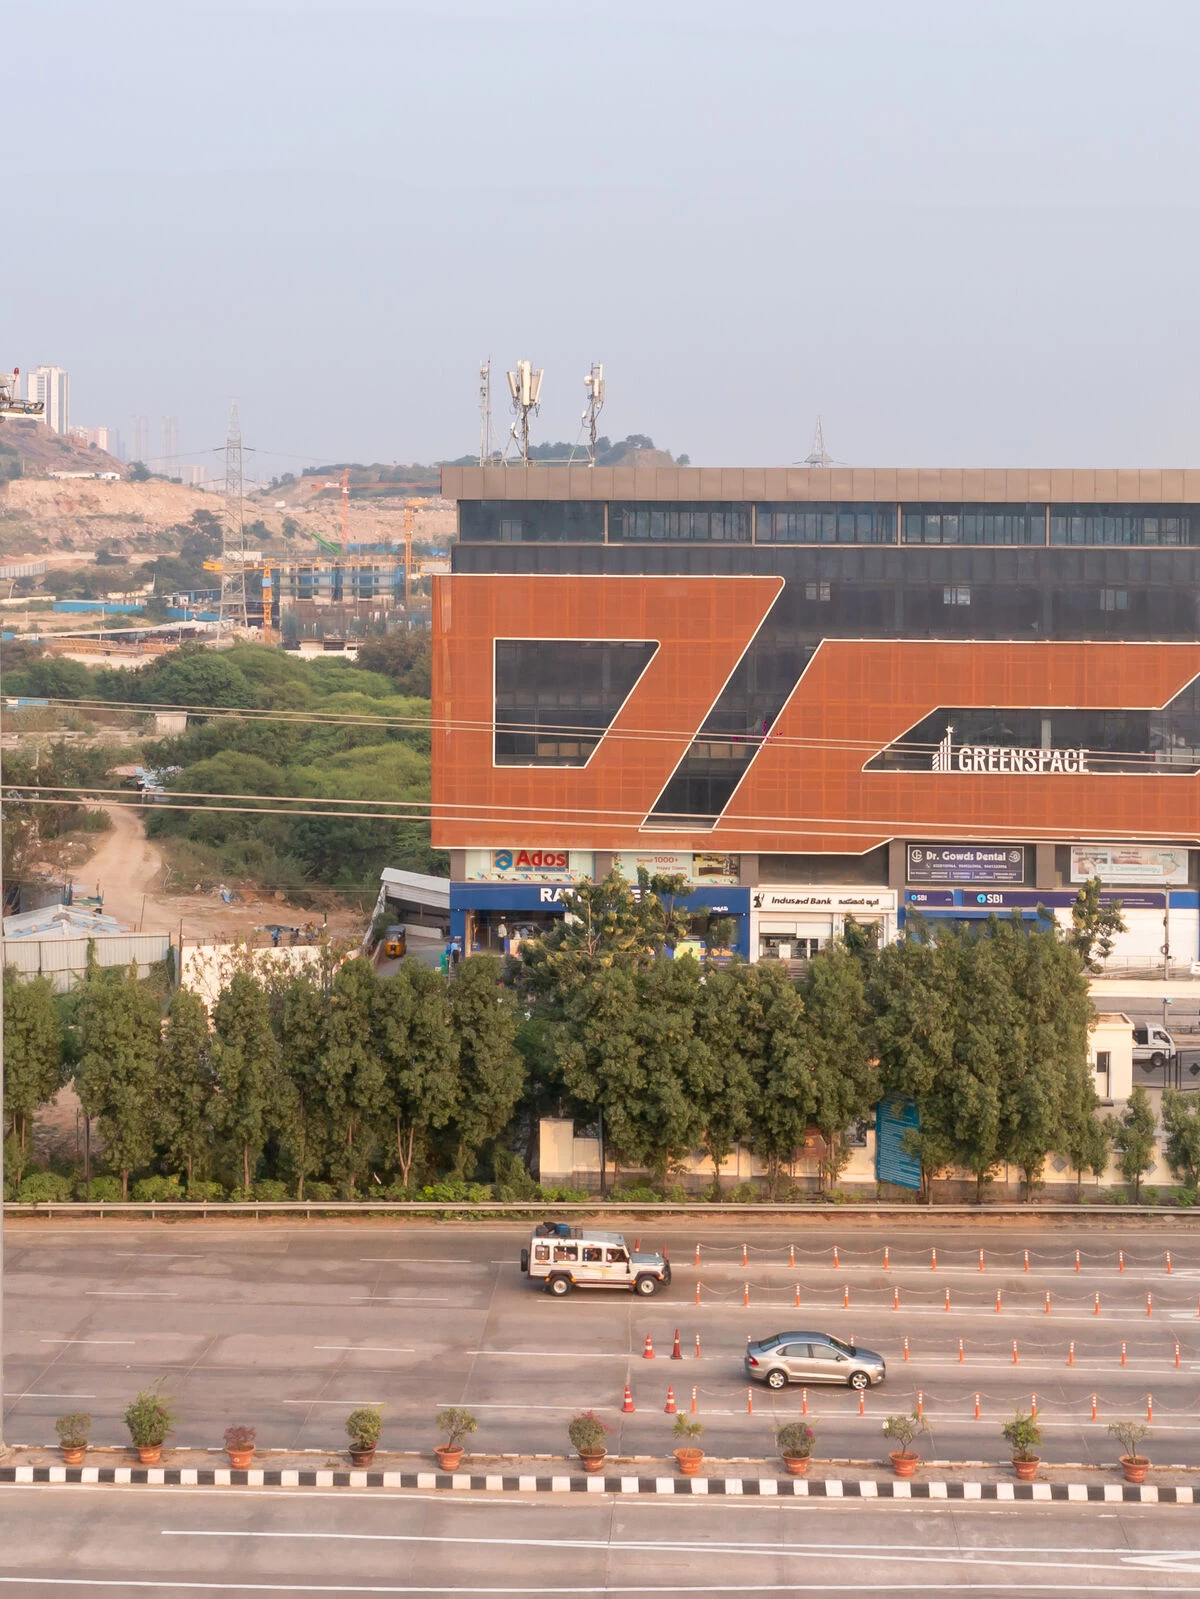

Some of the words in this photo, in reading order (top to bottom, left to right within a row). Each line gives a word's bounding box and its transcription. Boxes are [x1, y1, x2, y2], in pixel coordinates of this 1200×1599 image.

[958, 747, 1090, 773] GREENSPACE
[516, 850, 567, 867] Ados
[654, 856, 679, 864] 1000+
[926, 851, 939, 861] Dr.
[942, 851, 974, 861] Gowds
[976, 851, 1006, 861] Dental
[771, 896, 809, 905] IndusInd
[810, 896, 832, 905] Bank
[986, 894, 1003, 904] SBI
